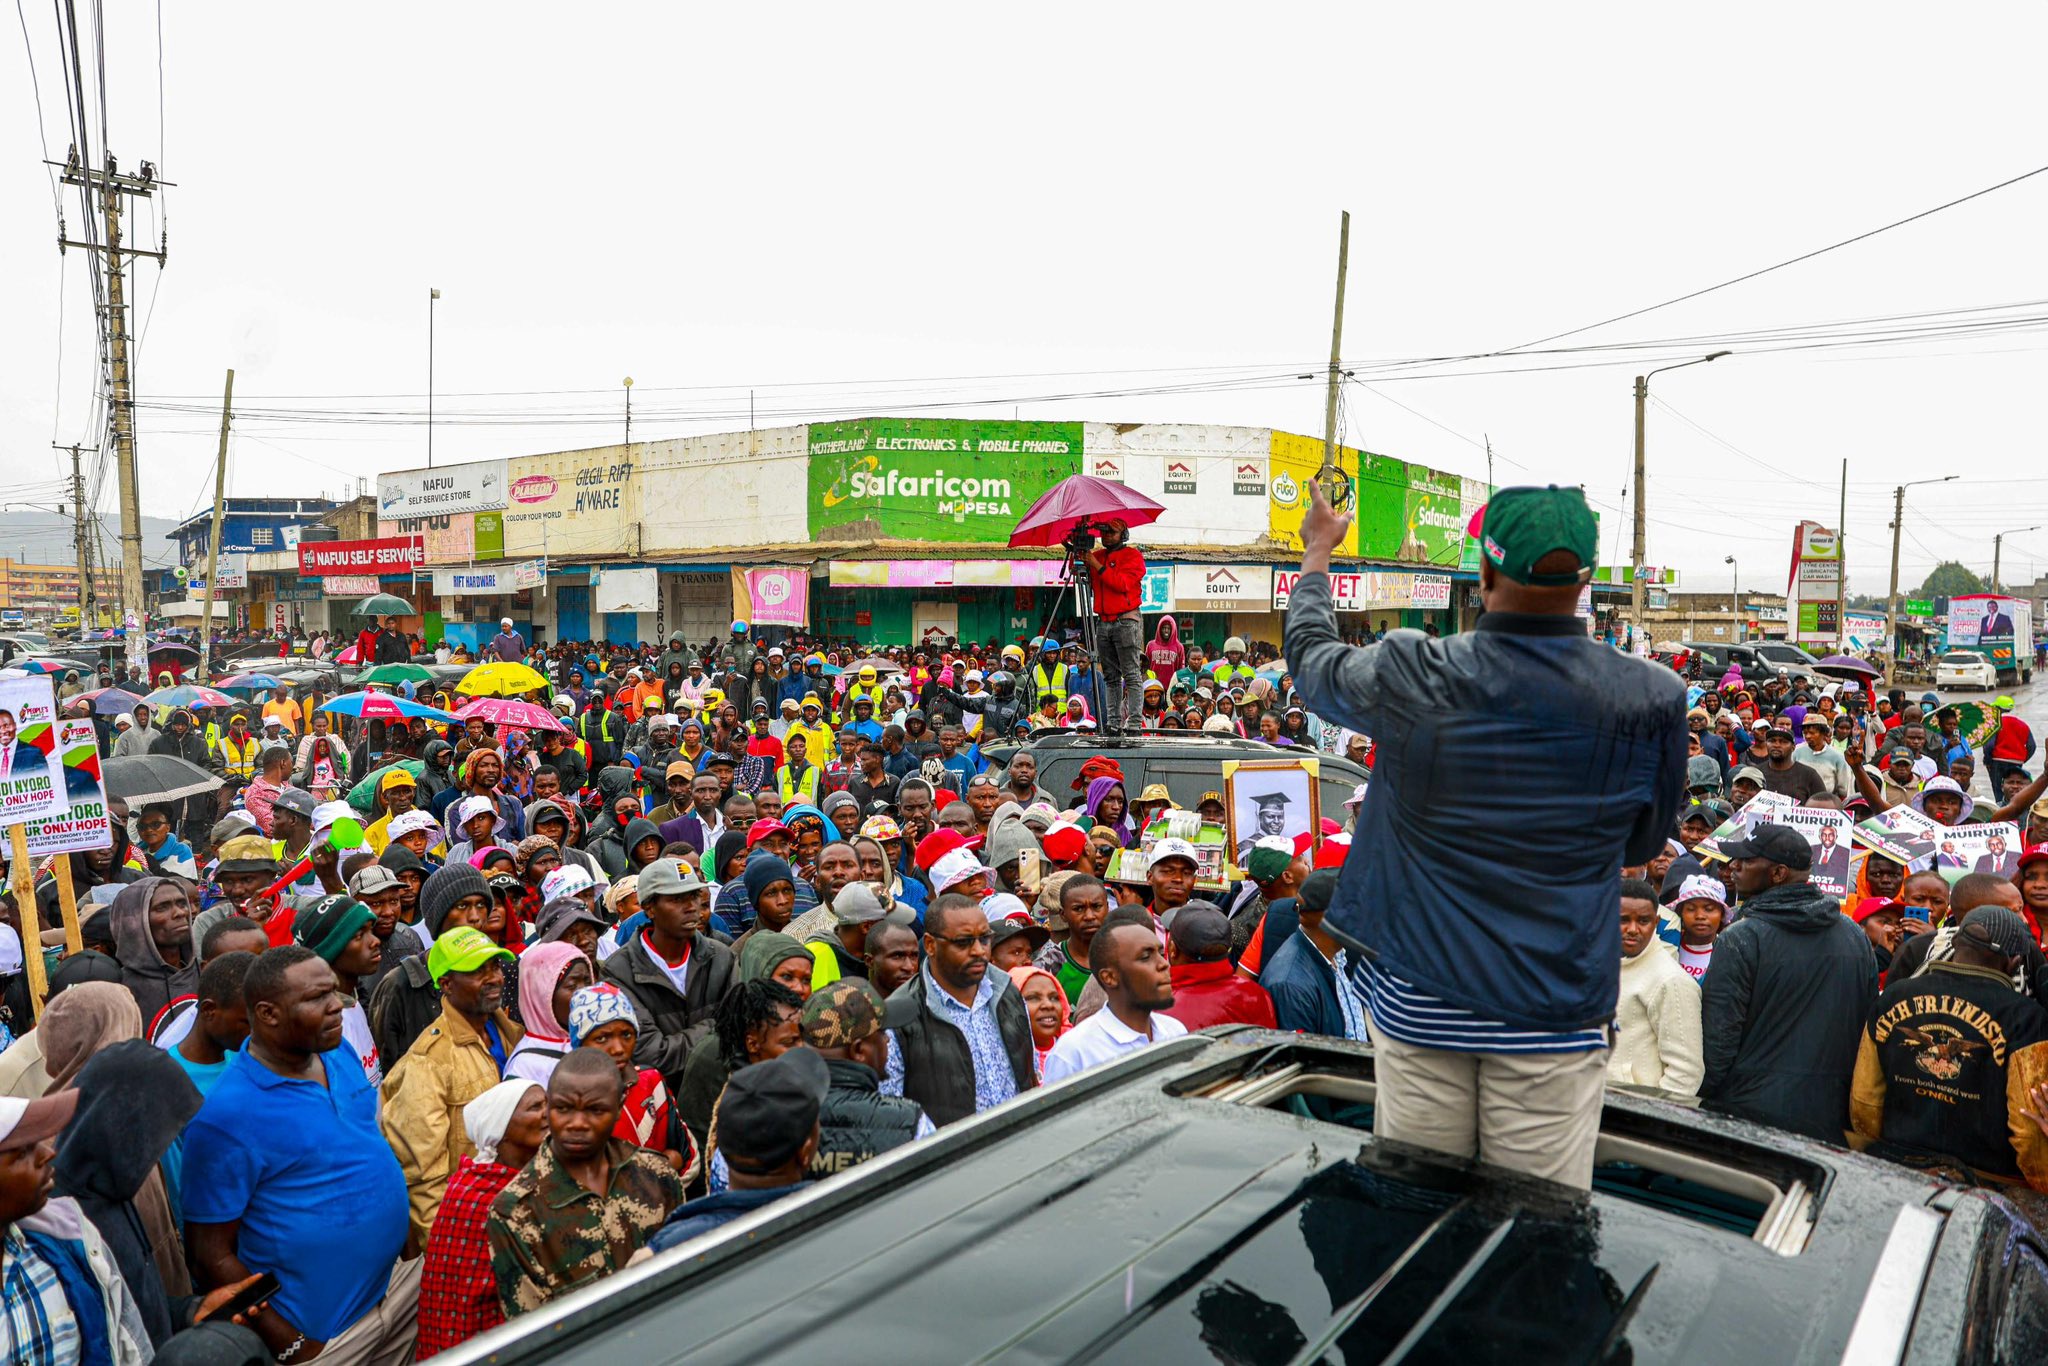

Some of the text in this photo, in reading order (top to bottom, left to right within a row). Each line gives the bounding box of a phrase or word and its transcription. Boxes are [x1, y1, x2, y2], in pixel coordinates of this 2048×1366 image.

[876, 437, 957, 451] ELECTRONICS
[961, 438, 971, 451] &
[978, 439, 1020, 452] MOBILE
[1022, 440, 1070, 454] PHONES
[575, 463, 634, 487] GILGIL RIFT
[422, 477, 454, 491] NAFUU
[850, 469, 1011, 498] Safaricom
[1276, 483, 1295, 495] FUGO
[408, 490, 471, 505] SELF SERVICE STORE
[575, 487, 620, 514] H/WARE
[506, 511, 562, 522] COLOUR YOUR WORLD
[1419, 506, 1461, 530] Safaricom
[317, 551, 348, 566] NAFUU
[350, 549, 375, 565] SELF
[376, 546, 423, 564] SERVICE
[453, 575, 496, 588] RIFT HARDWARE
[673, 573, 724, 584] TYRANNUS
[1413, 575, 1451, 584] FARMWILL
[764, 581, 784, 597] itel
[1206, 585, 1240, 593] EQUITY
[1412, 584, 1449, 599] AGROVET
[1206, 601, 1238, 609] AGENT
[26, 705, 49, 715] PEOPLE'S
[15, 775, 52, 795] NYORO
[5, 794, 28, 806] ONLY
[30, 789, 55, 802] HOPE
[1791, 808, 1837, 817] THIONG'O
[43, 822, 73, 836] ONLY
[75, 818, 108, 832] HOPE
[1782, 814, 1843, 827] MUIRURI
[52, 832, 82, 840] ECONOMY
[1944, 827, 2010, 840] MUIRURI
[36, 839, 59, 847] NATION
[1808, 874, 1835, 883] 2027
[1875, 999, 1914, 1043] WITH
[1894, 1074, 1916, 1085] From
[1917, 1077, 1936, 1088] both
